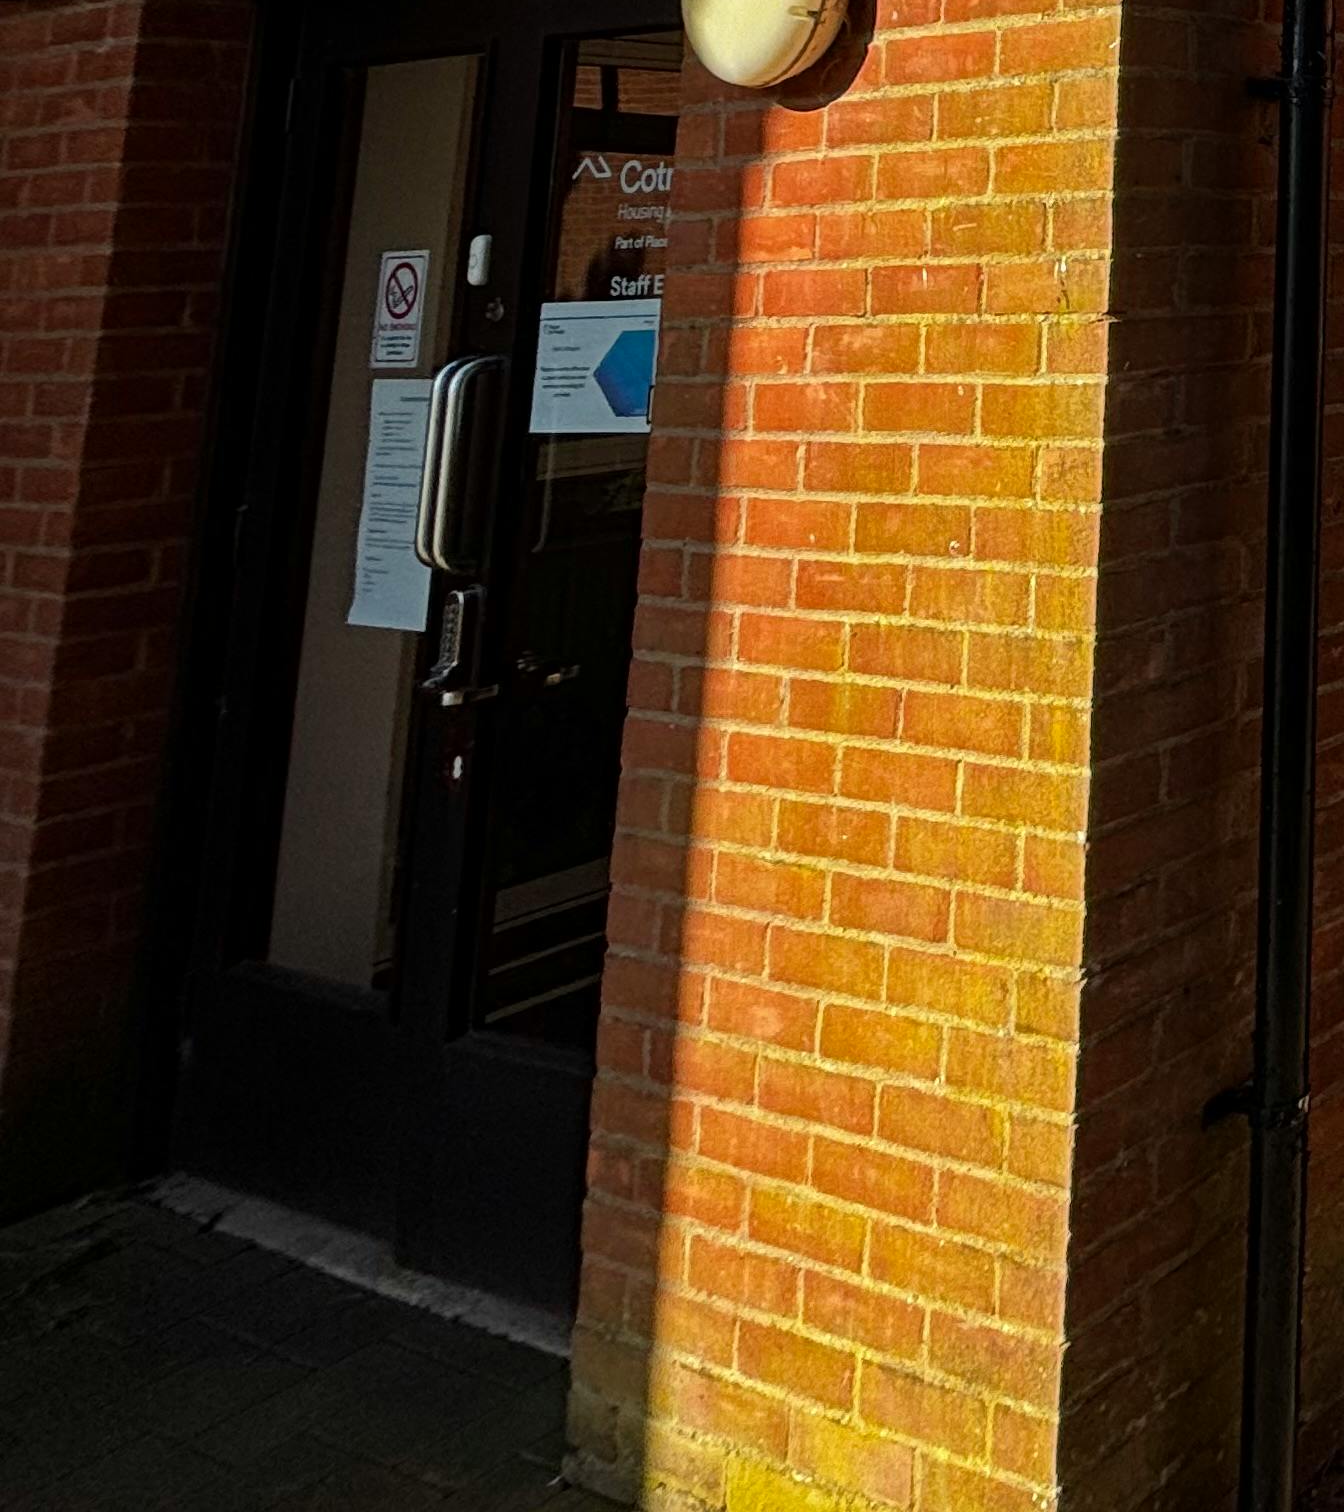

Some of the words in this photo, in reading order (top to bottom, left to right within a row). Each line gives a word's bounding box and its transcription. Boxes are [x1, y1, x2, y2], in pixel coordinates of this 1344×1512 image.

[619, 159, 673, 194] Cot
[617, 203, 664, 223] Housing
[610, 275, 652, 297] Staff
